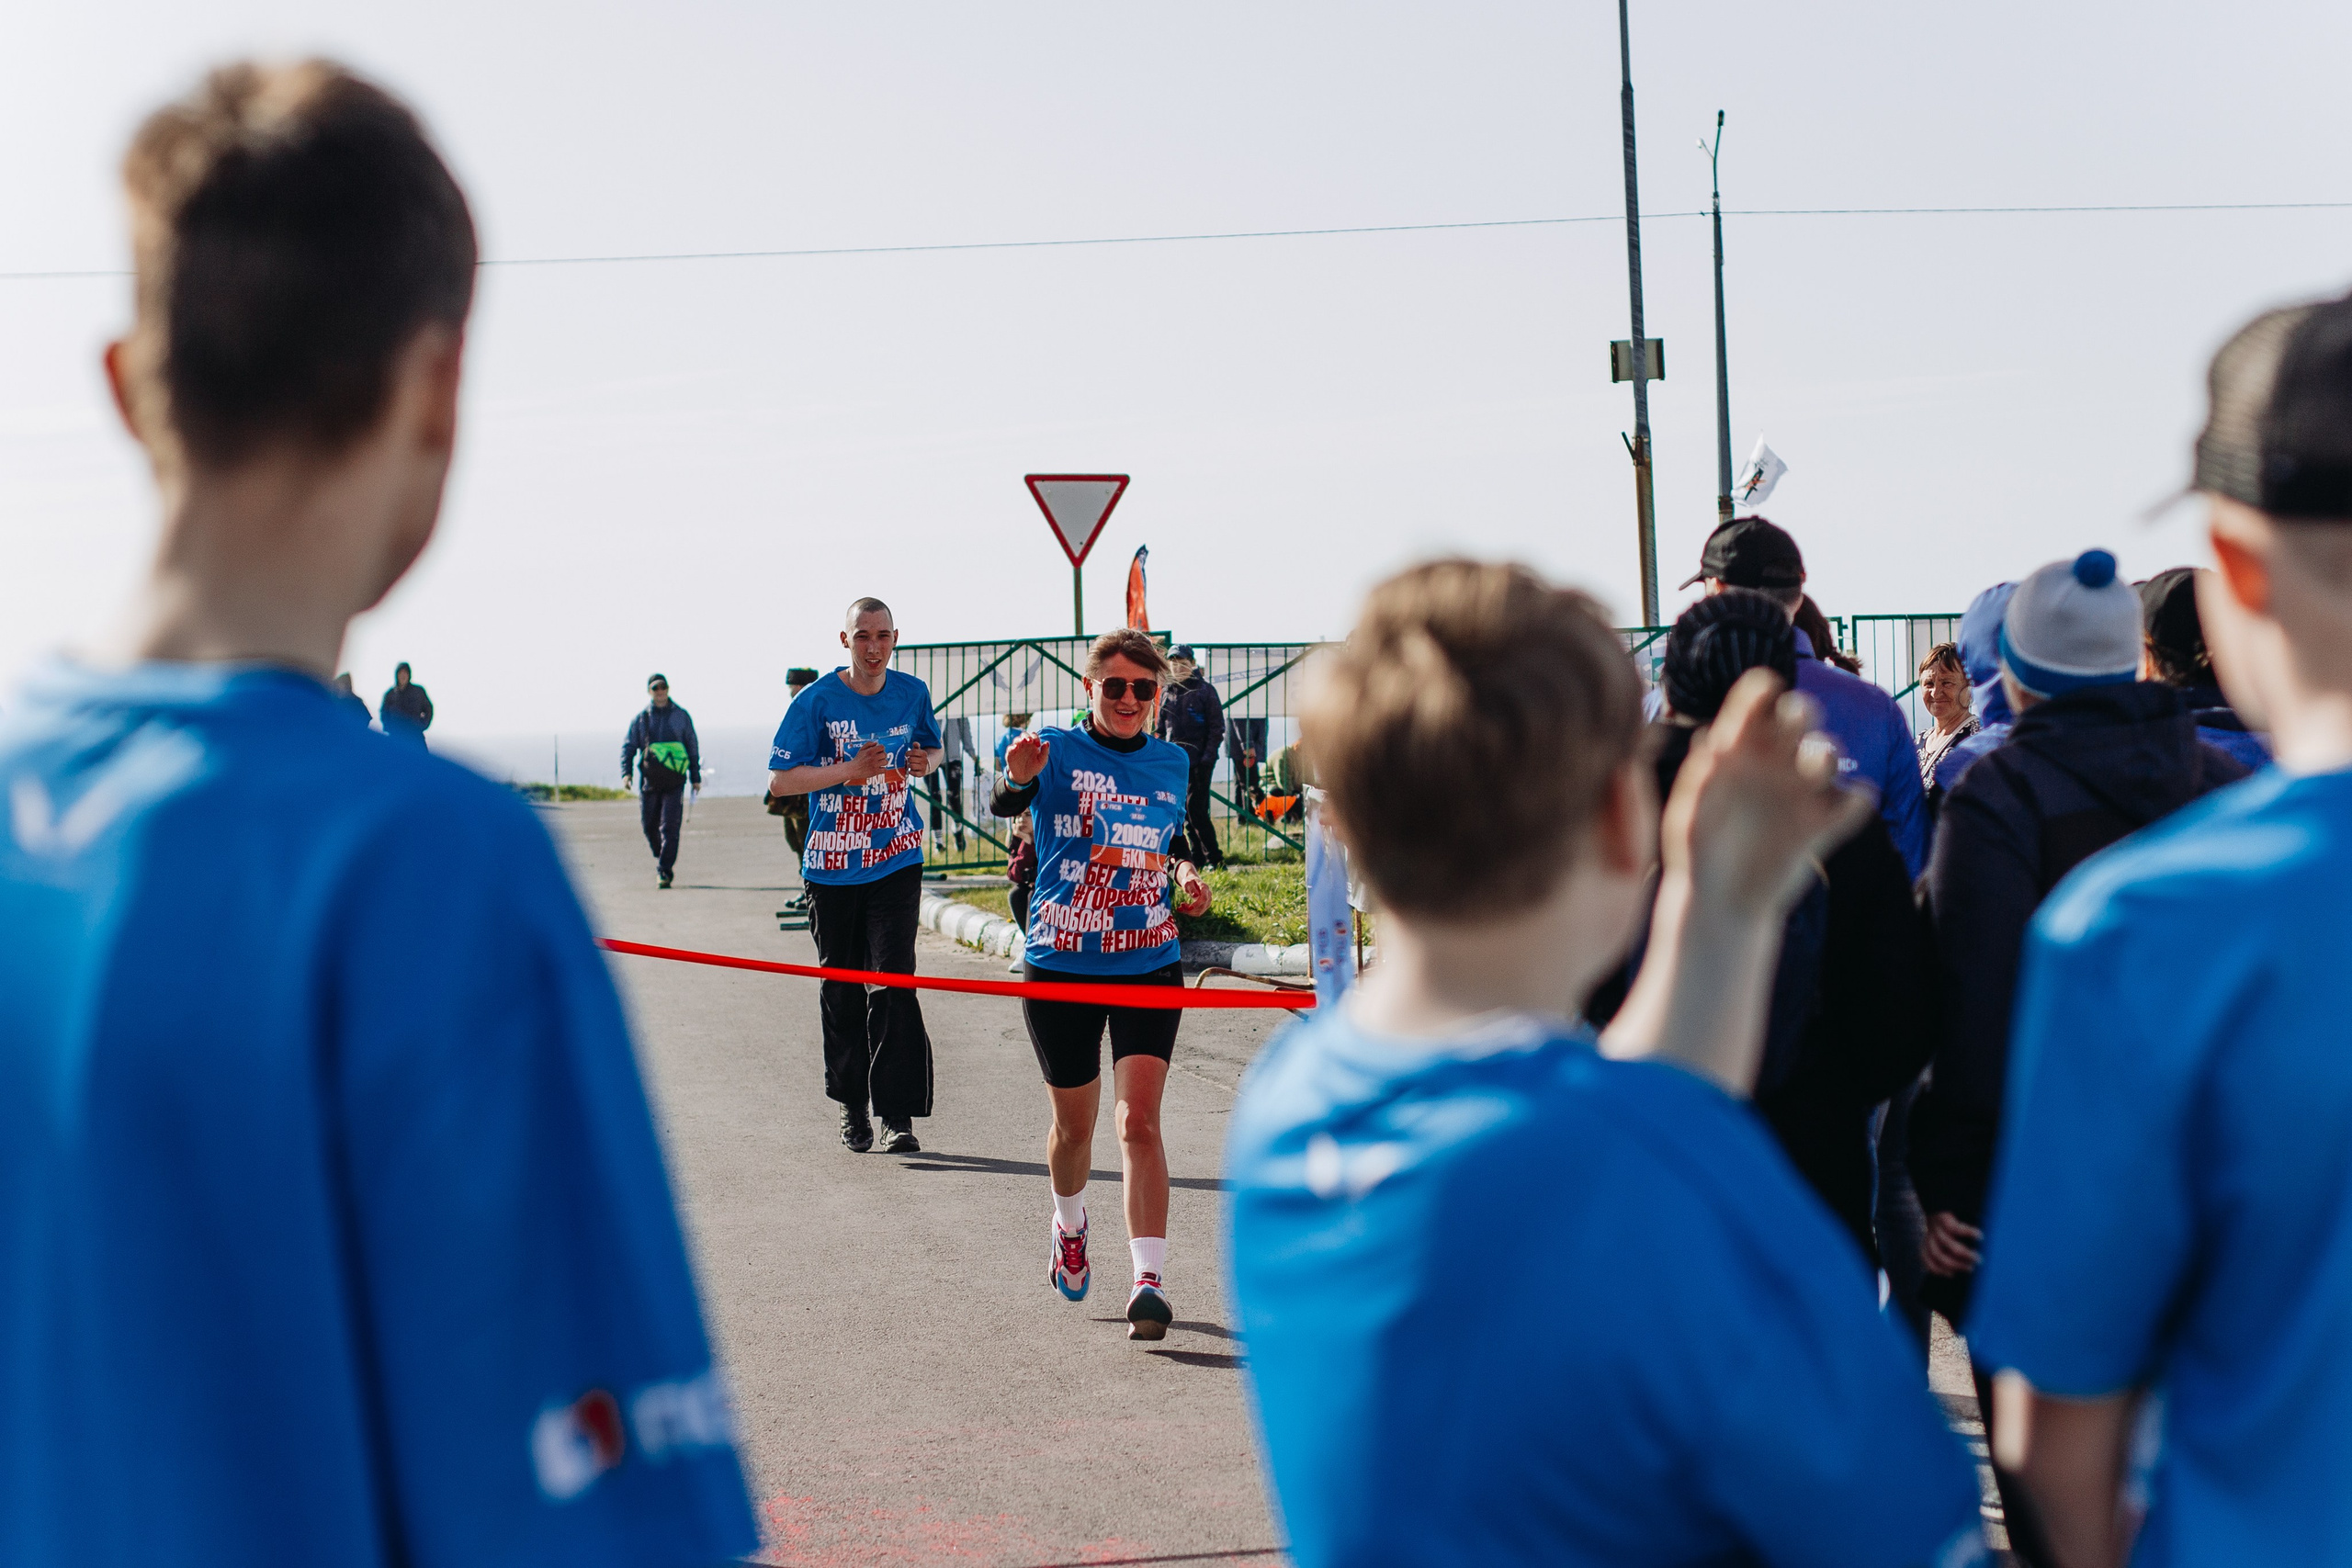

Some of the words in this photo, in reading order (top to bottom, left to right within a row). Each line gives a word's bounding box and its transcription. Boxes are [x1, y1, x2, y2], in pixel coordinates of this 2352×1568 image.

[1071, 769, 1117, 794] 2024
[820, 794, 868, 814] #ЗАБЕГ
[836, 807, 903, 832] #ГОРДОСТ
[1110, 822, 1160, 850] 20025
[804, 850, 848, 870] #ЗАБЕГ
[1058, 859, 1117, 886] #ЗАБЕГ
[1072, 884, 1160, 910] #ГОРДОСТЬ
[1039, 902, 1114, 932] #ЛЮБОВЬ
[1032, 921, 1082, 953] #ЗАБЕГ
